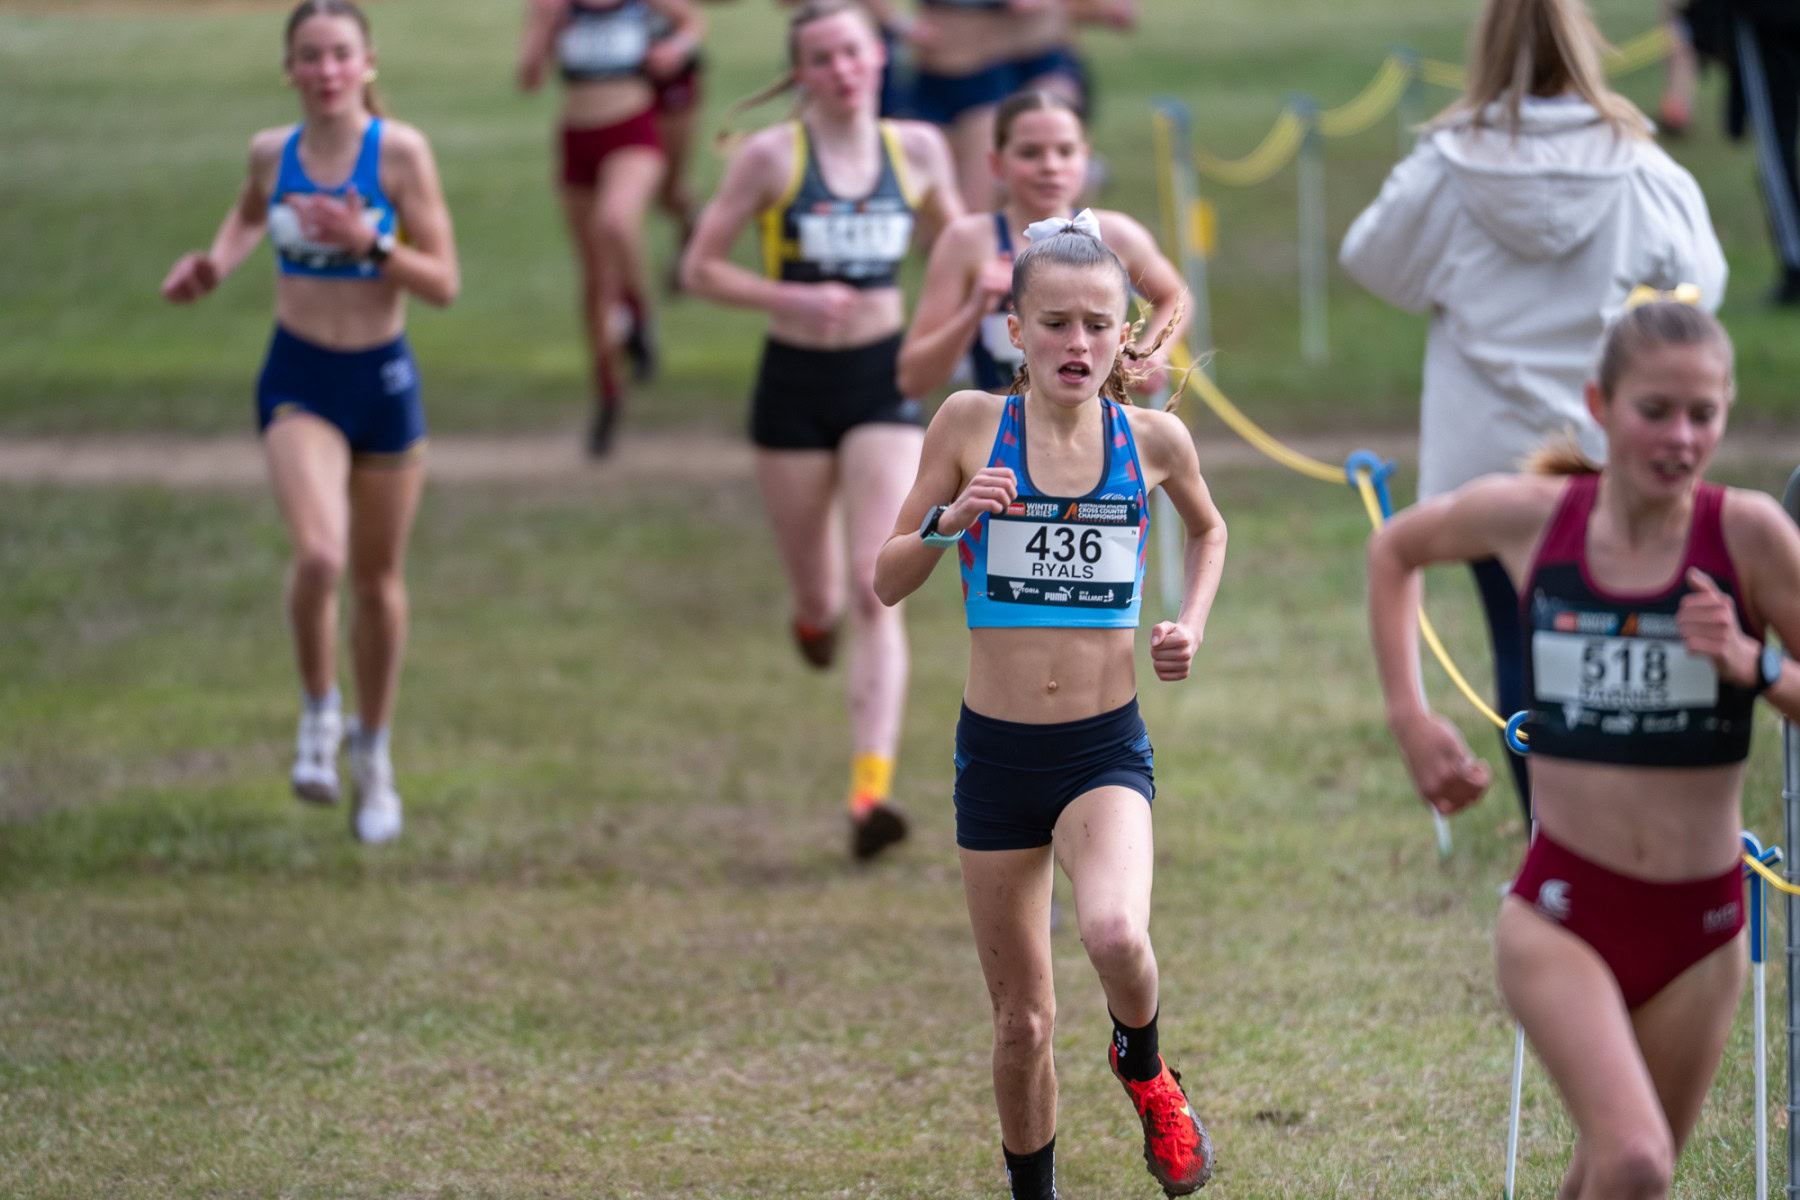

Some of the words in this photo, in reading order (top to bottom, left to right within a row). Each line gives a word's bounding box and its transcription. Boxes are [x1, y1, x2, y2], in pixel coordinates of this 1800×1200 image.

[1026, 502, 1059, 511] WINTER
[1026, 510, 1052, 518] SERIES
[1077, 512, 1128, 520] CHAMPIONSHIPS
[1026, 526, 1102, 564] 436
[1031, 562, 1095, 579] RYALS
[1044, 592, 1068, 602] PUMA
[1582, 642, 1668, 687] 518
